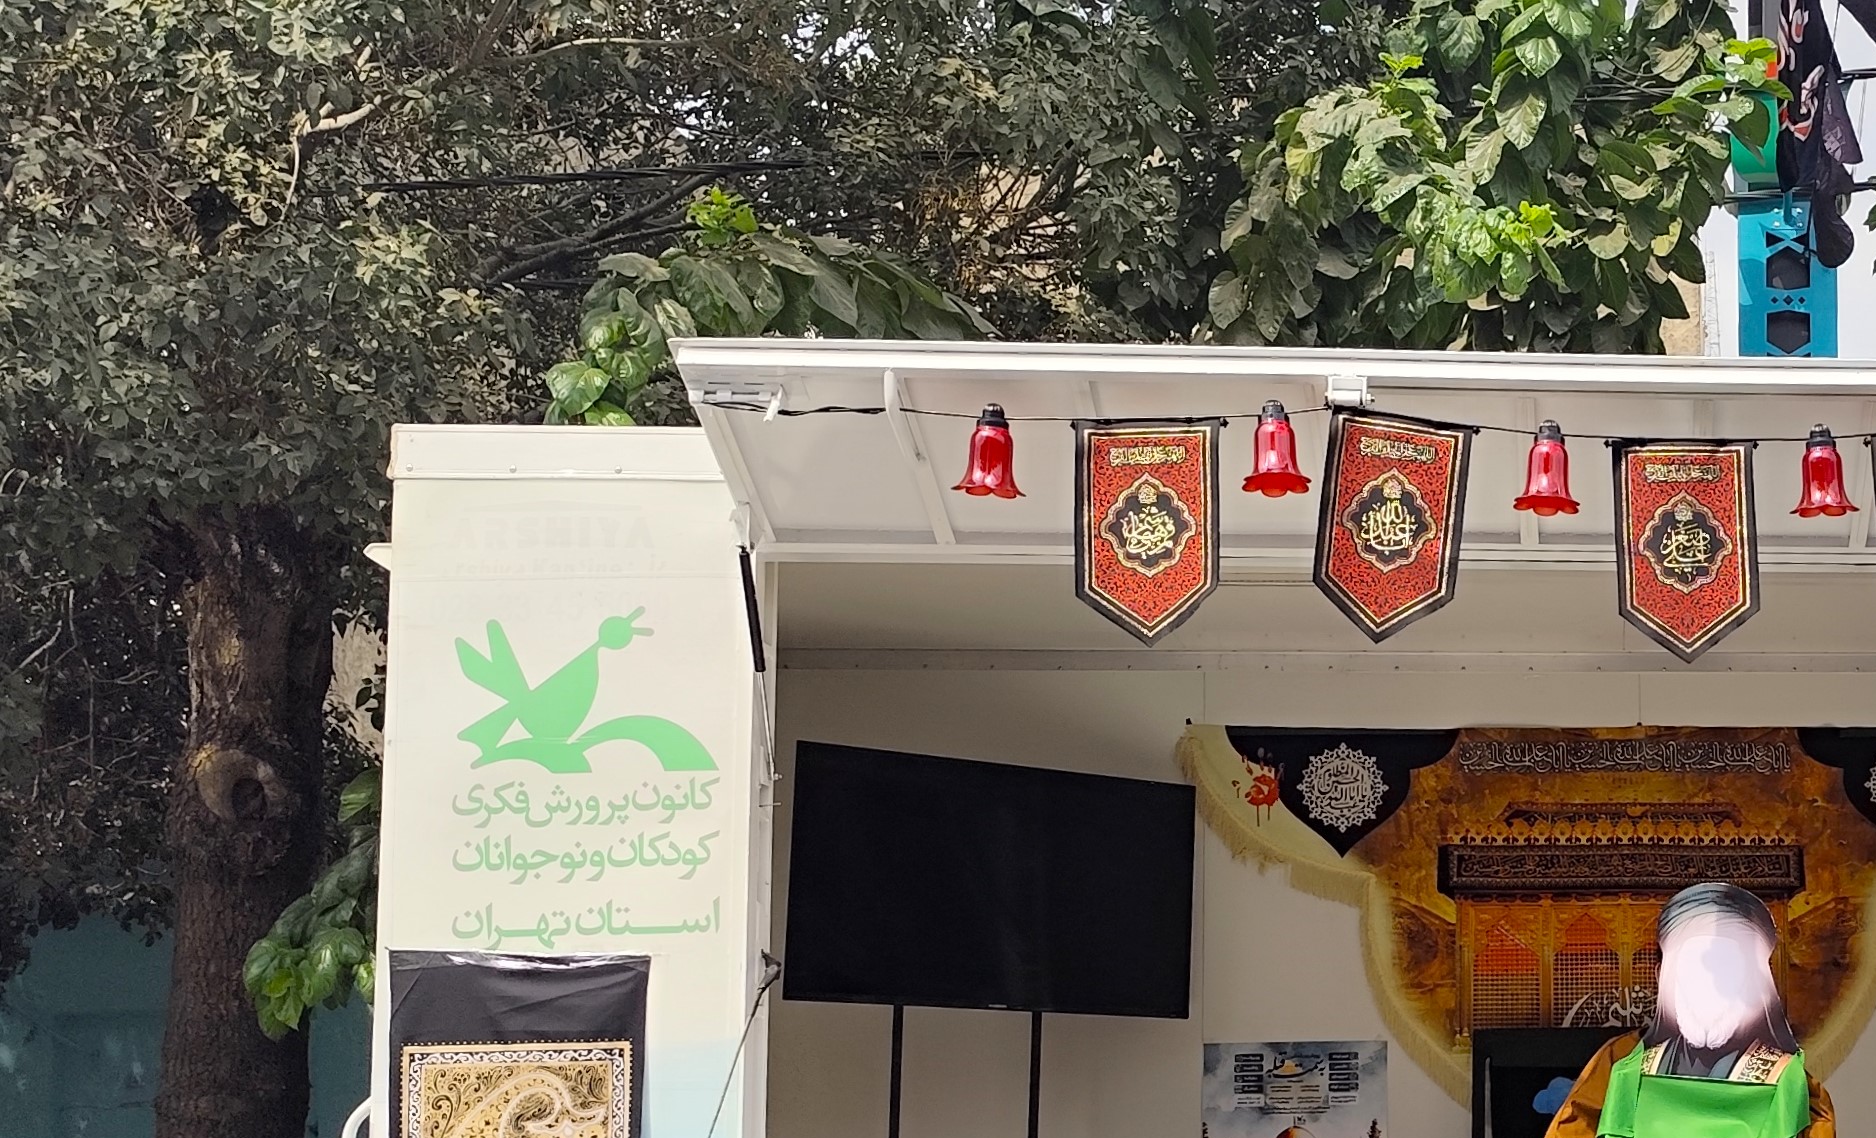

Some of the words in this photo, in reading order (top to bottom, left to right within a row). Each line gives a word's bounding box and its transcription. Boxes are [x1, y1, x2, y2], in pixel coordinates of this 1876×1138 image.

[452, 781, 530, 829] فکری
[525, 784, 630, 828] پرورش
[632, 777, 721, 824] کانون
[451, 834, 588, 885] نوجوانان
[585, 850, 605, 882] و
[607, 830, 721, 880] کودکان
[451, 901, 571, 950] تهران
[575, 895, 721, 936] استان
